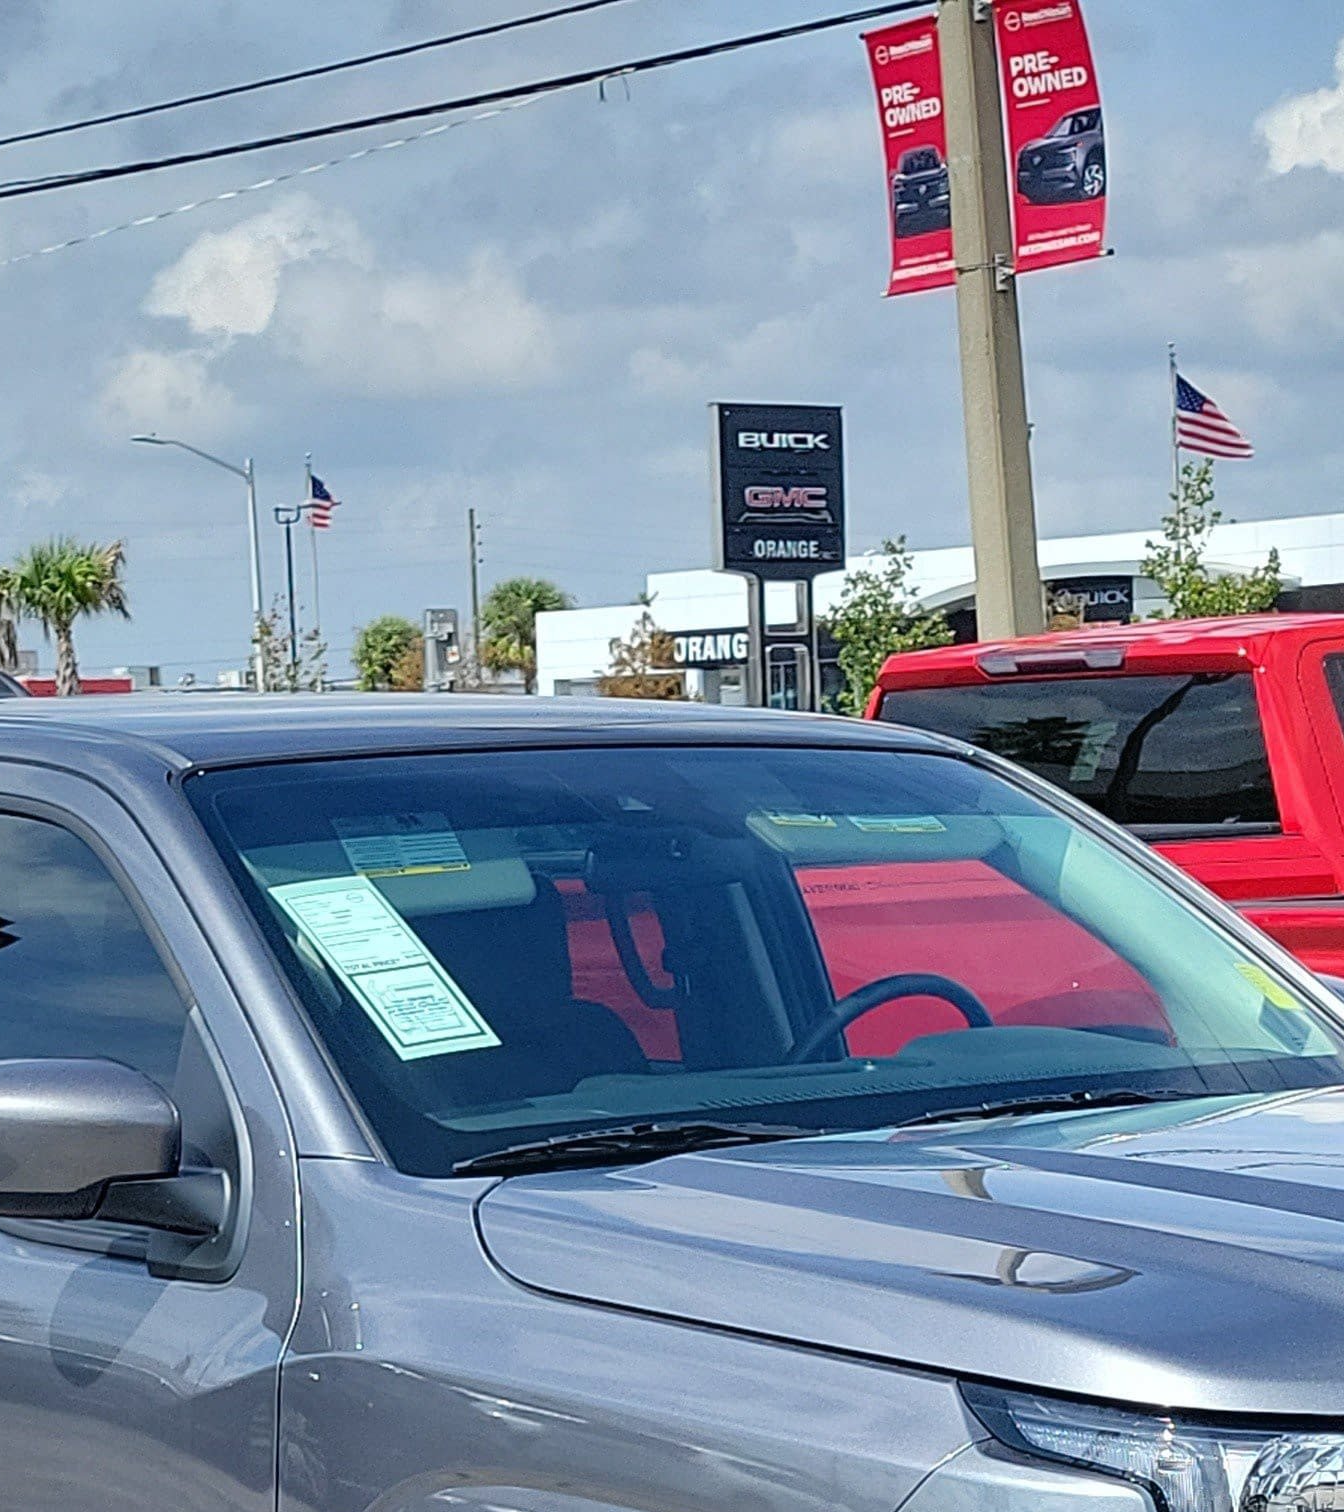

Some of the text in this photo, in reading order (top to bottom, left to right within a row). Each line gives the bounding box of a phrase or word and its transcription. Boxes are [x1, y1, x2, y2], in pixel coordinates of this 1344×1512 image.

[1009, 50, 1060, 77] PRE-
[881, 82, 920, 107] PRE-
[1013, 66, 1088, 98] OWNED
[885, 97, 942, 127] OWNED
[737, 432, 830, 450] BUICK
[744, 486, 827, 508] GMC
[753, 539, 820, 559] ORANGE
